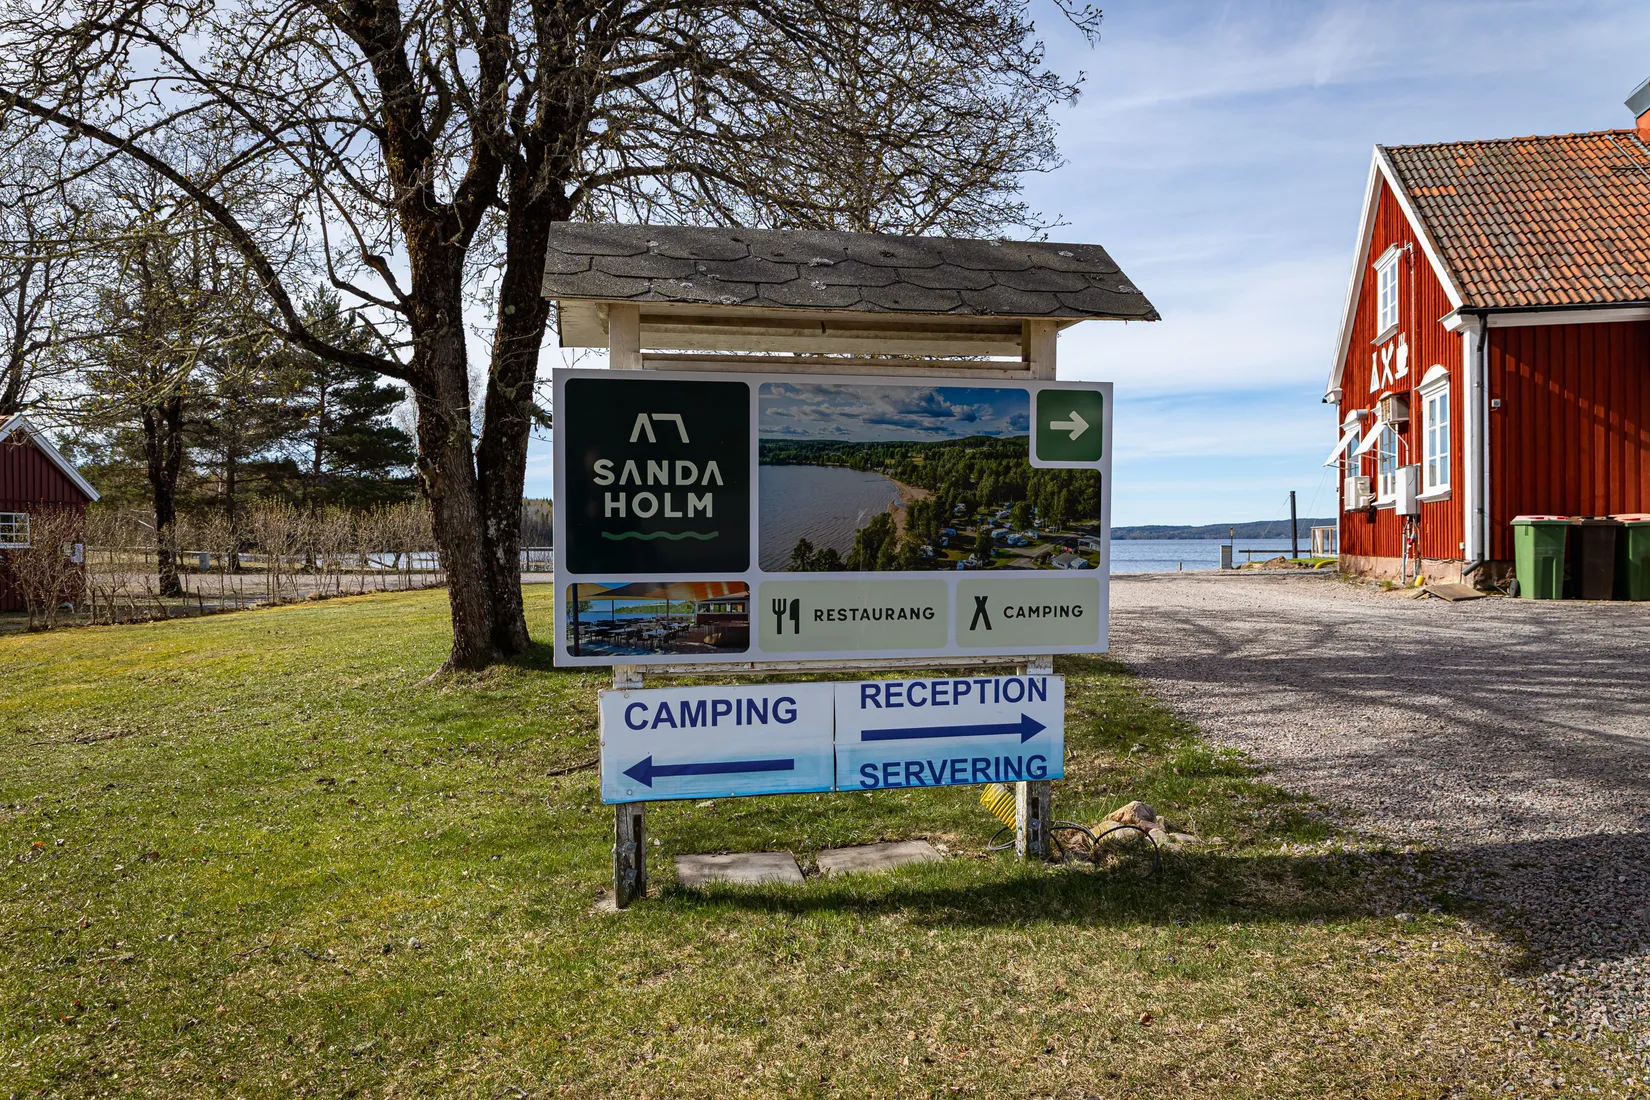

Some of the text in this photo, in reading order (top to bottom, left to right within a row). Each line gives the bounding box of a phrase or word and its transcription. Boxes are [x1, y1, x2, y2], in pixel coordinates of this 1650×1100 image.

[593, 458, 724, 486] SANDA
[604, 491, 713, 518] HOLM
[813, 606, 936, 624] RESTAURANG
[1002, 604, 1084, 620] CAMPING
[860, 677, 1047, 709] RECEPTION
[624, 696, 797, 731] CAMPING
[859, 754, 1048, 789] SERVERING
